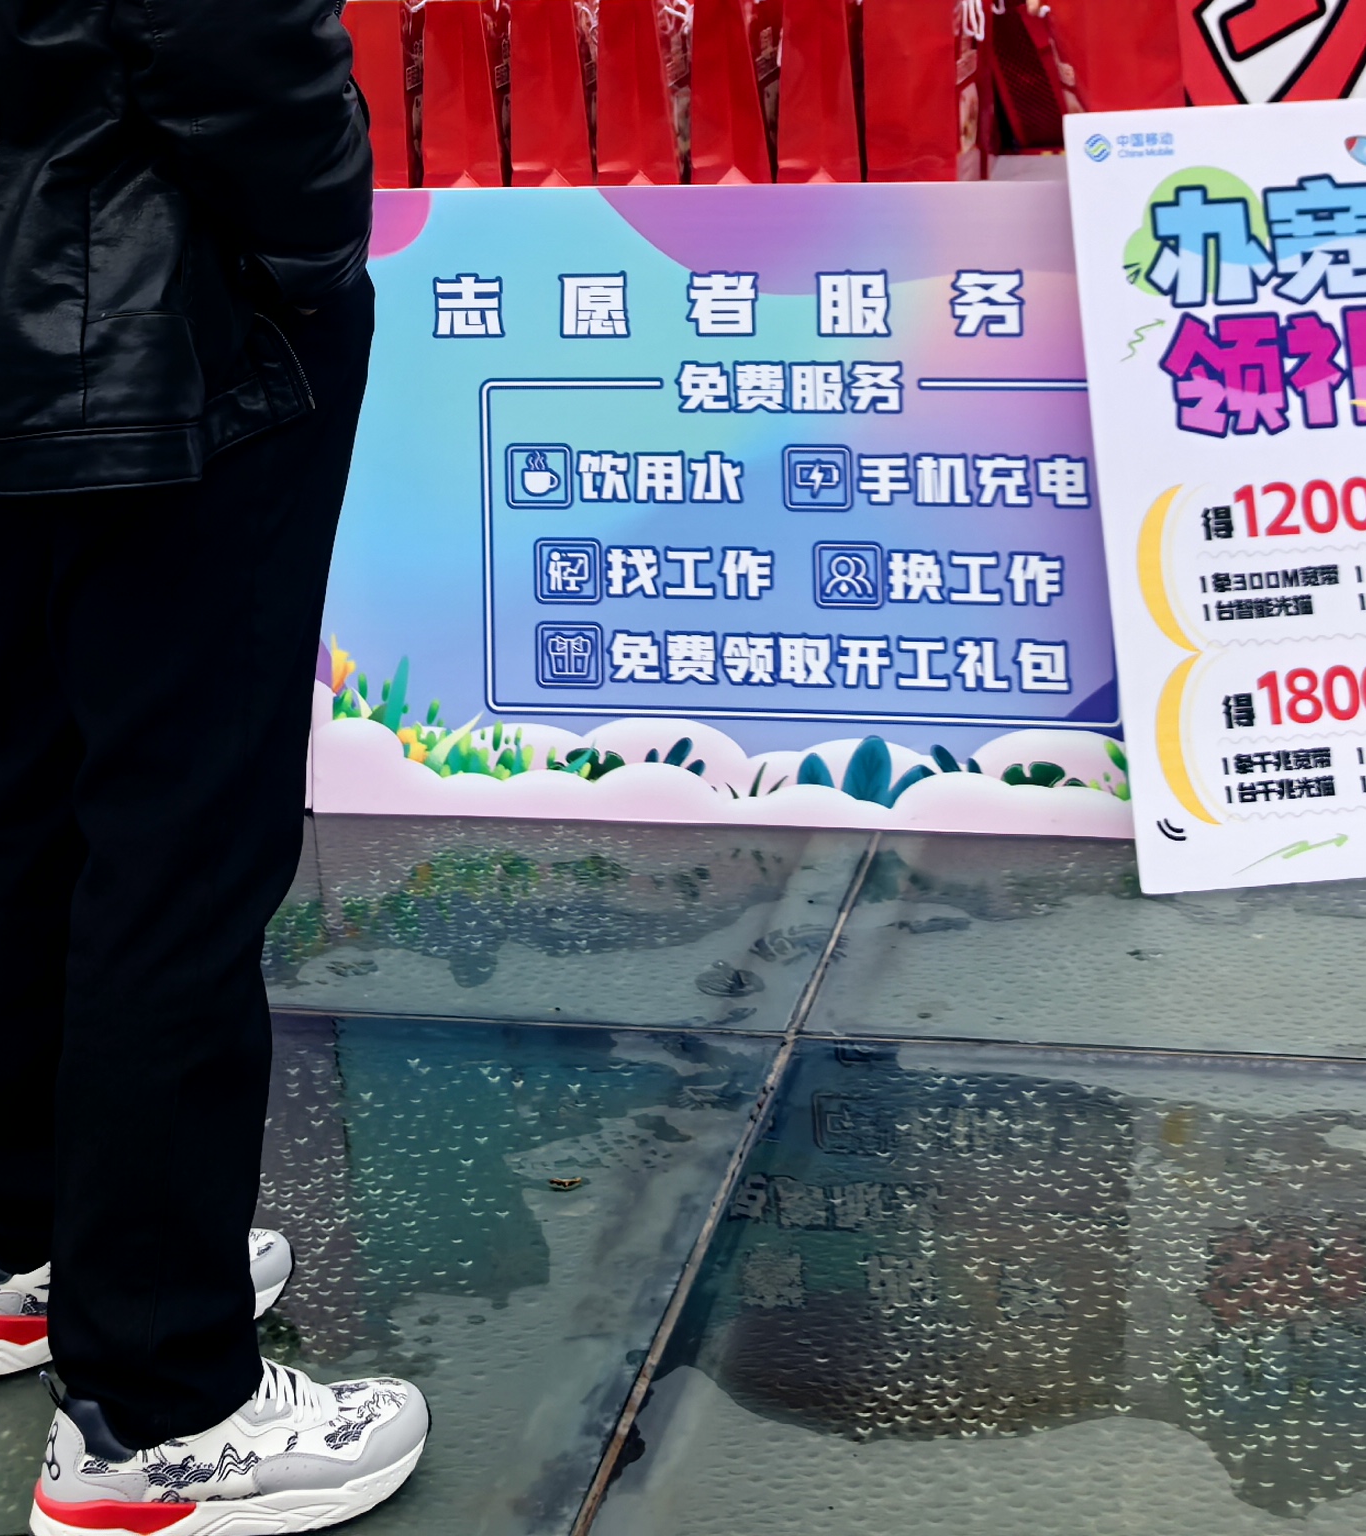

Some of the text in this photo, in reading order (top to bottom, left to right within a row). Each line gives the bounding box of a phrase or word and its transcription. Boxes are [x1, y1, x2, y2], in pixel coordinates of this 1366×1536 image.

[1116, 133, 1174, 147] 中国移动
[433, 268, 1026, 341] 志愿者服务
[677, 360, 905, 415] 免费服务
[576, 450, 746, 506] 饮用水
[857, 451, 1092, 510] 手机充电
[605, 545, 774, 600] 找工作
[888, 550, 1065, 607] 换工作
[608, 631, 1073, 695] 免费领取开工礼包
